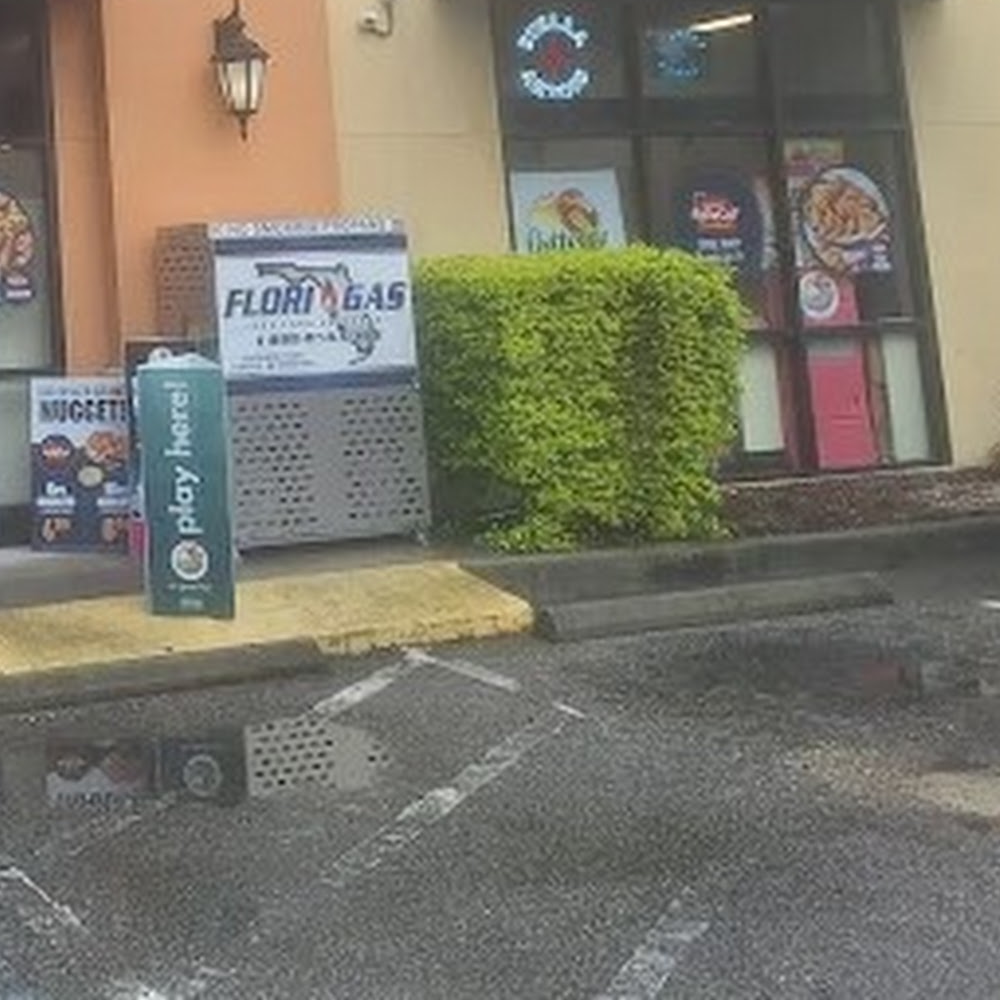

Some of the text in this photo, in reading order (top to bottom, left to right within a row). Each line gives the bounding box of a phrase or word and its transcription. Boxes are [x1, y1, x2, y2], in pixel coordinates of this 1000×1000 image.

[343, 281, 406, 311] GAS
[163, 381, 204, 534] play here!
